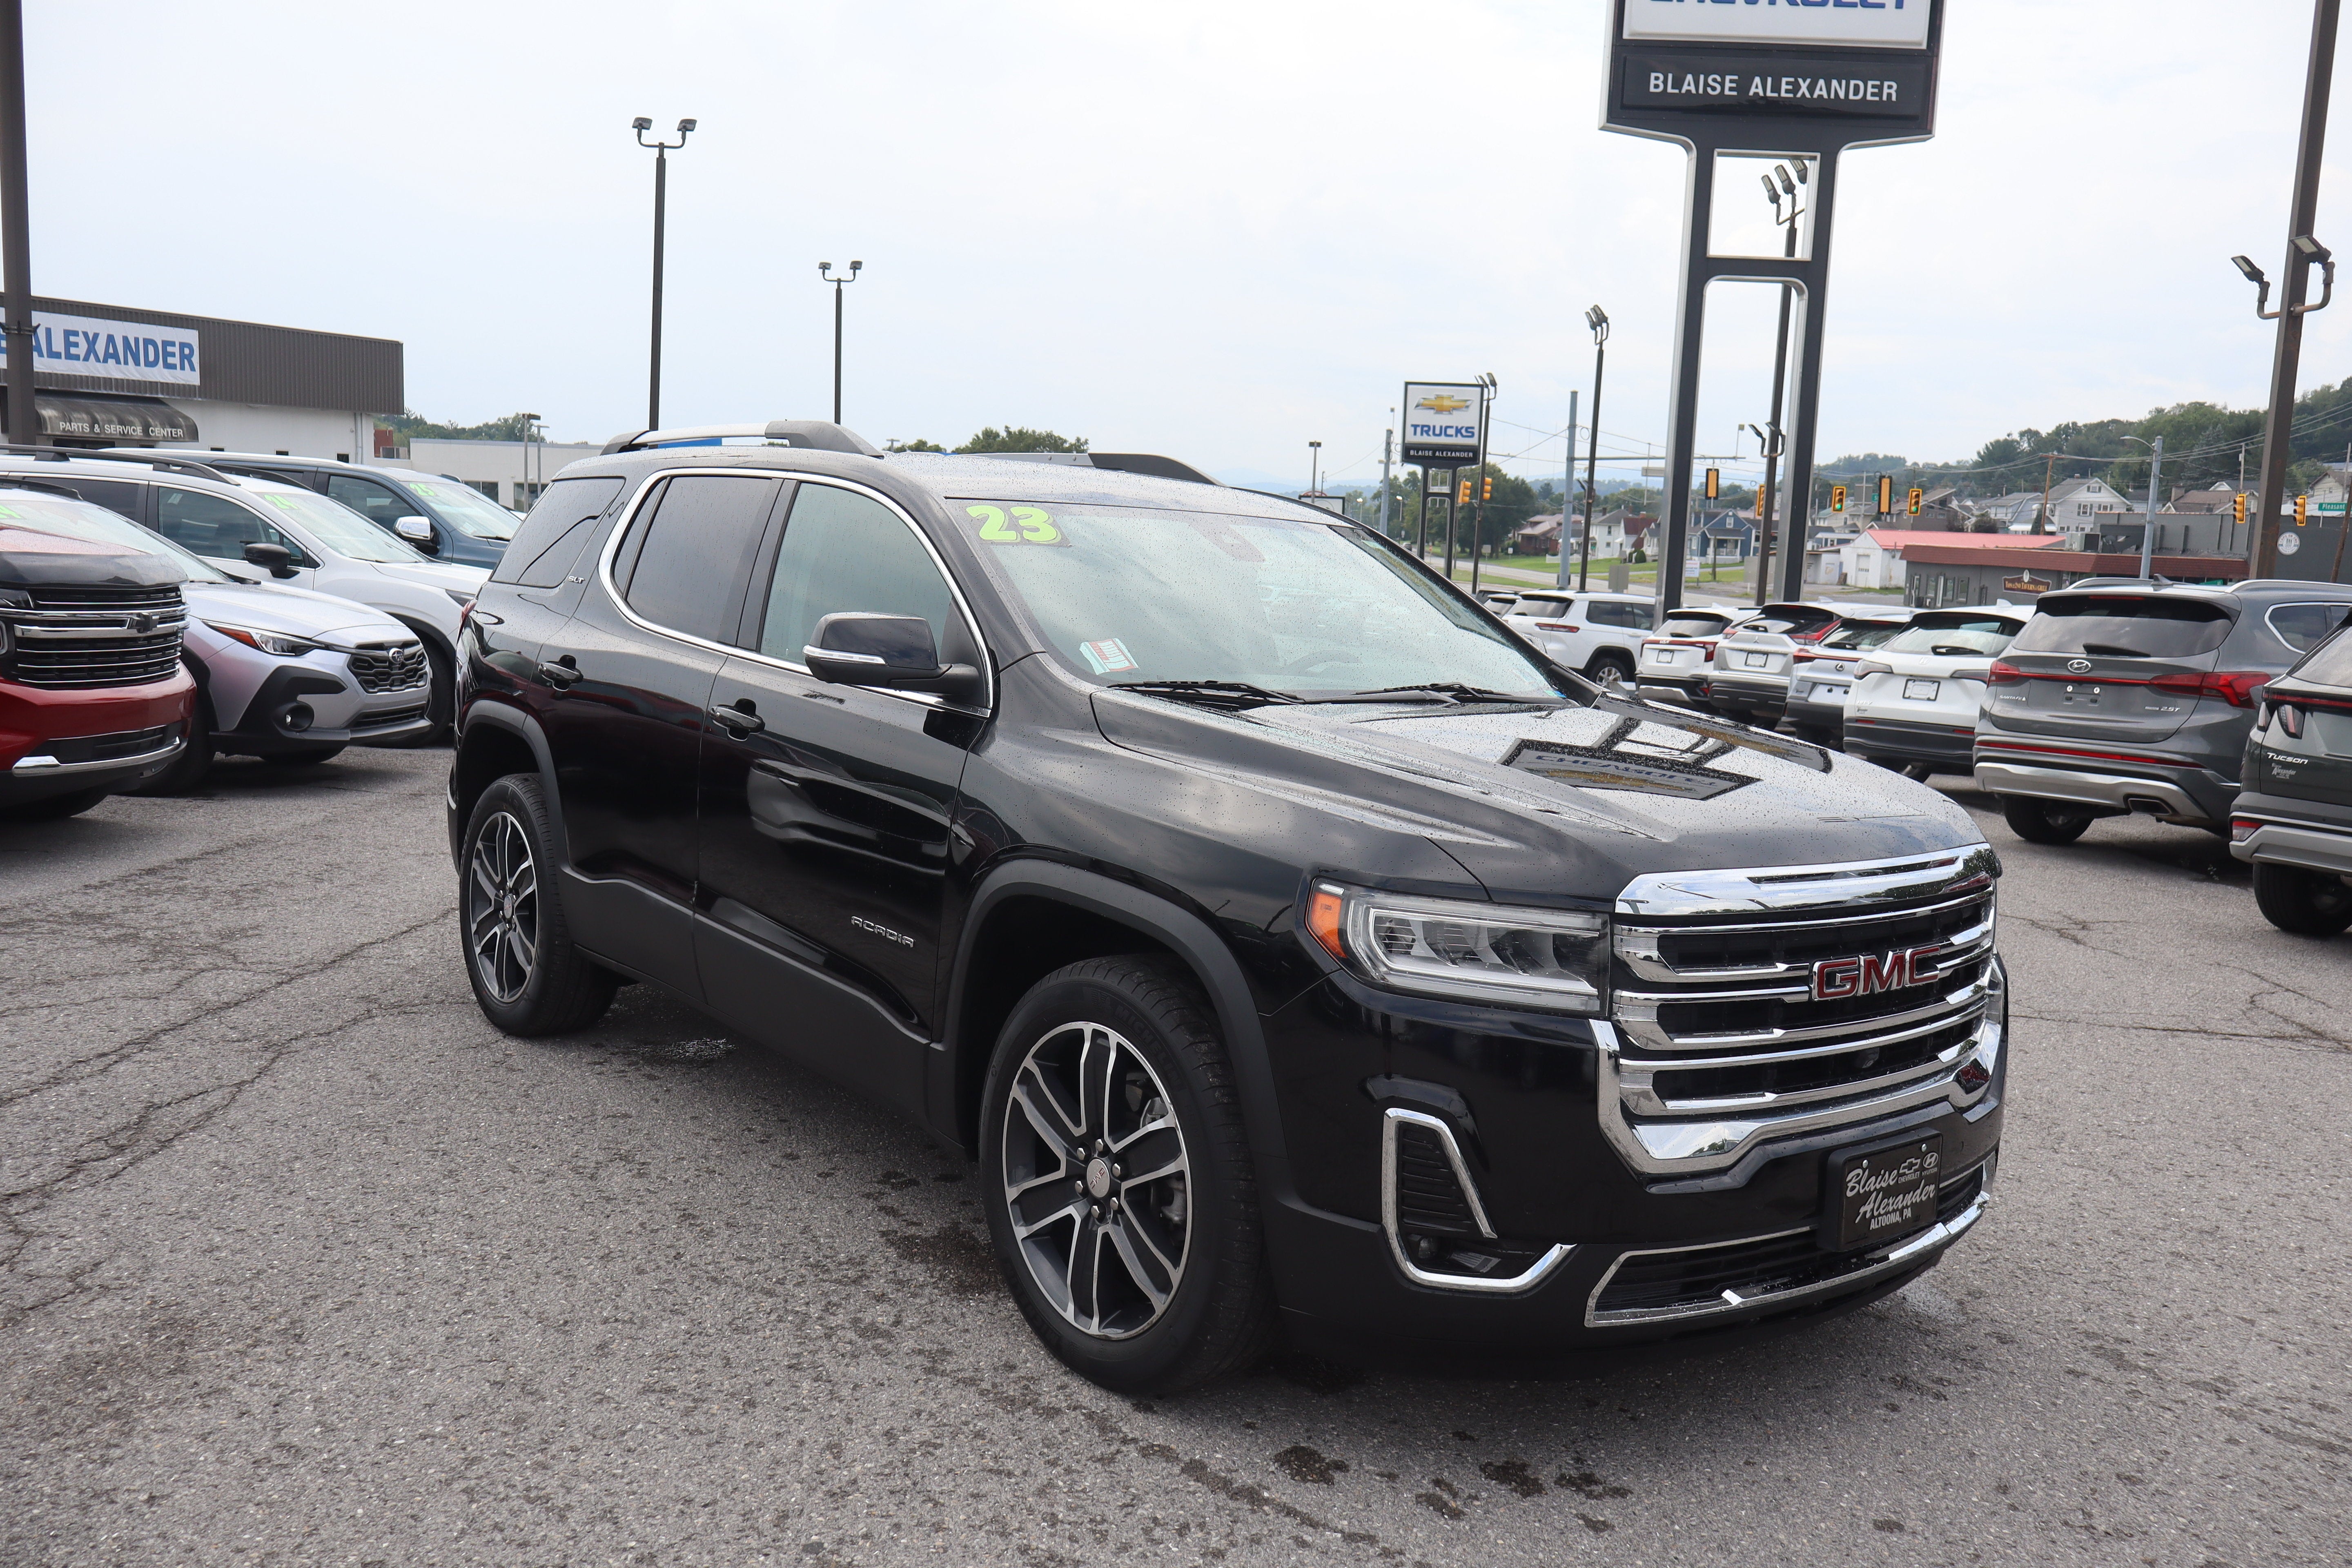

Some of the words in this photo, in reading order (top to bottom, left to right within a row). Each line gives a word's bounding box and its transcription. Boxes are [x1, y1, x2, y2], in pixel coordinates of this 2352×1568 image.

[1649, 72, 1738, 96] BLAISE
[1748, 76, 1898, 102] ALEXANDER
[33, 327, 196, 372] ALEXANDER
[60, 422, 89, 432] PARTS
[94, 425, 100, 433] &
[105, 424, 143, 435] SERVICE
[149, 427, 183, 437] CENTER
[1410, 424, 1475, 438] TRUCKS
[409, 483, 435, 496] 25
[264, 495, 298, 509] 24
[966, 505, 1061, 543] 23
[851, 916, 914, 948] ACADIA
[1812, 946, 1940, 1001] GMC
[1089, 1167, 1105, 1189] GMC
[1846, 1167, 1898, 1197] Blaise
[1898, 1171, 1920, 1183] CHEVROLET
[1922, 1167, 1938, 1176] HYUNDAI
[1855, 1179, 1936, 1224] Alexander
[1870, 1210, 1902, 1230] ALTOONA,
[1903, 1207, 1911, 1220] PA
